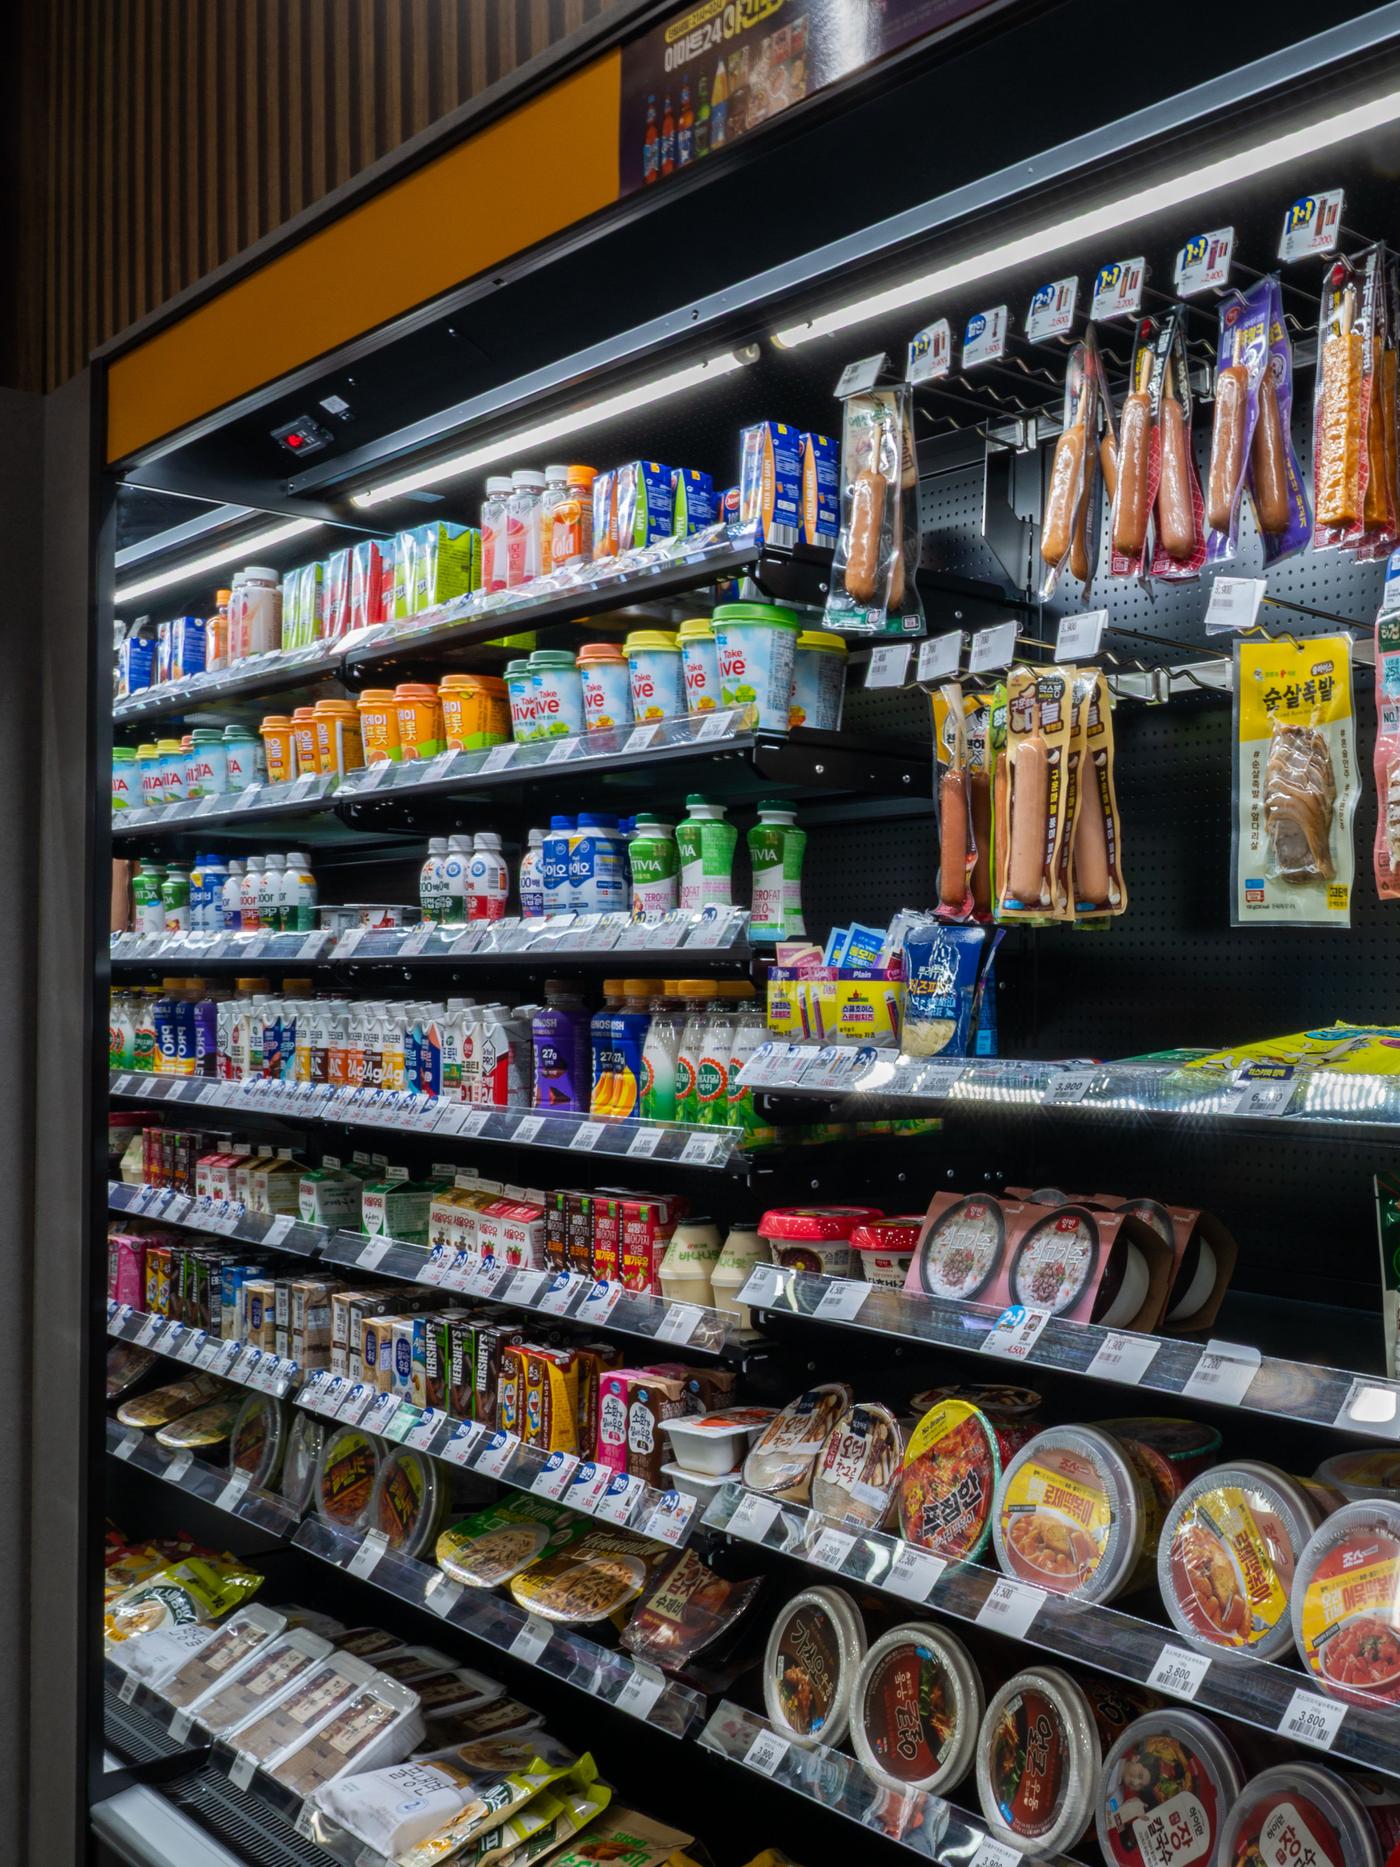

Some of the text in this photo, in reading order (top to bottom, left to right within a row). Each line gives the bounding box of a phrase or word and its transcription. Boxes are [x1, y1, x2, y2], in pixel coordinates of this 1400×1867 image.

[1293, 201, 1312, 224] 1+1
[1184, 239, 1206, 263] 1+1
[1101, 268, 1120, 287] 1+1
[1036, 288, 1054, 305] 2+1
[636, 508, 645, 531] APPLE
[724, 650, 743, 659] Take
[633, 674, 651, 683] Take
[687, 664, 704, 673] Take
[538, 690, 558, 699] Take
[585, 683, 603, 692] Take
[1263, 676, 1335, 712] 순살족발
[853, 971, 872, 979] Plain
[483, 1056, 494, 1067] PRO
[542, 1049, 557, 1060] 27g
[1061, 1218, 1076, 1229] 양반
[1004, 1309, 1022, 1324] 2+1
[426, 1323, 435, 1378] HERSHEY'S
[452, 1330, 461, 1385] HERSHEY'S
[476, 1333, 488, 1392] HERSHEY'S
[841, 1436, 866, 1464] 오뎅
[1043, 1483, 1095, 1527] 로제떡볶이
[790, 1619, 825, 1688] 가쓰오
[1165, 1664, 1191, 1681] 3,800
[896, 1699, 924, 1761] 얼큰
[1299, 1711, 1325, 1728] 3,800
[757, 1746, 774, 1760] 3,900
[1026, 1713, 1052, 1777] 얼큰
[1148, 1816, 1174, 1866] 칼국수
[1170, 1821, 1193, 1851] 장
[1279, 1825, 1302, 1857] 장
